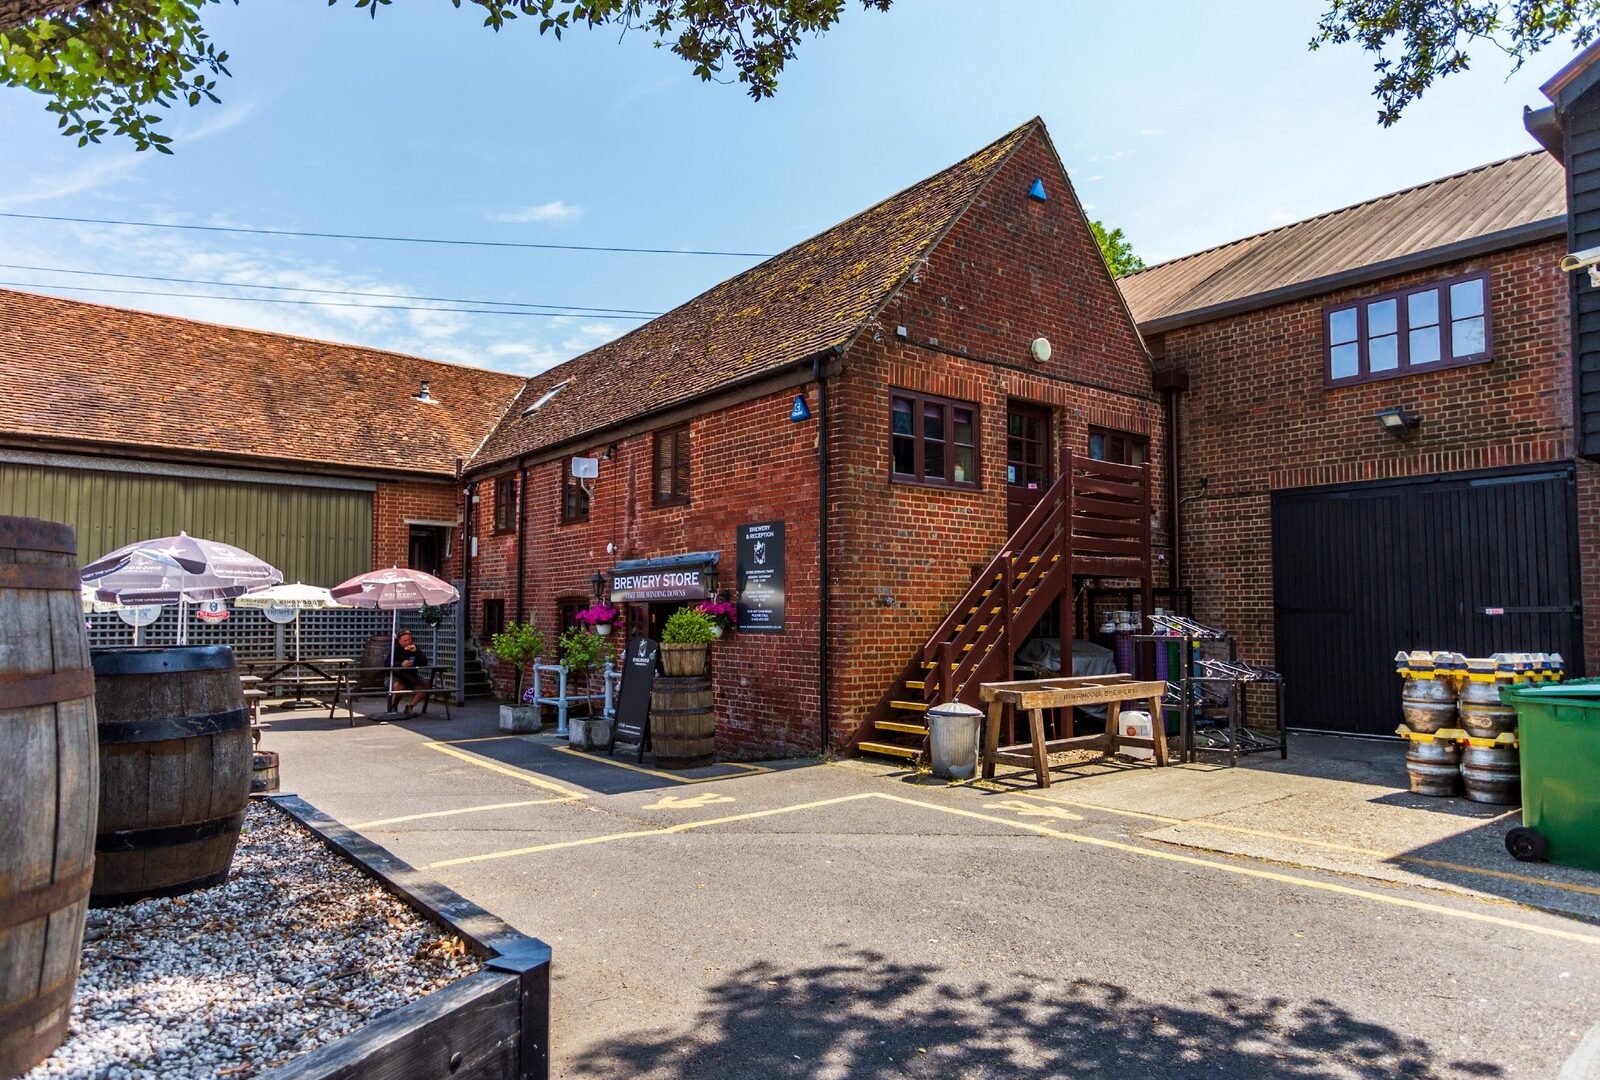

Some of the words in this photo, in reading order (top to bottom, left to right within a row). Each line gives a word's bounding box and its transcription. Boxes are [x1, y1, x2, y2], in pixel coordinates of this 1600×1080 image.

[750, 531, 774, 539] RECEPTION
[613, 574, 661, 590] BREWERY
[663, 571, 700, 587] STORE
[624, 591, 636, 599] VISIT
[636, 590, 646, 599] THE
[646, 590, 667, 599] WINDING
[667, 589, 686, 597] DOWNS
[1063, 691, 1101, 700] RINGWOOD
